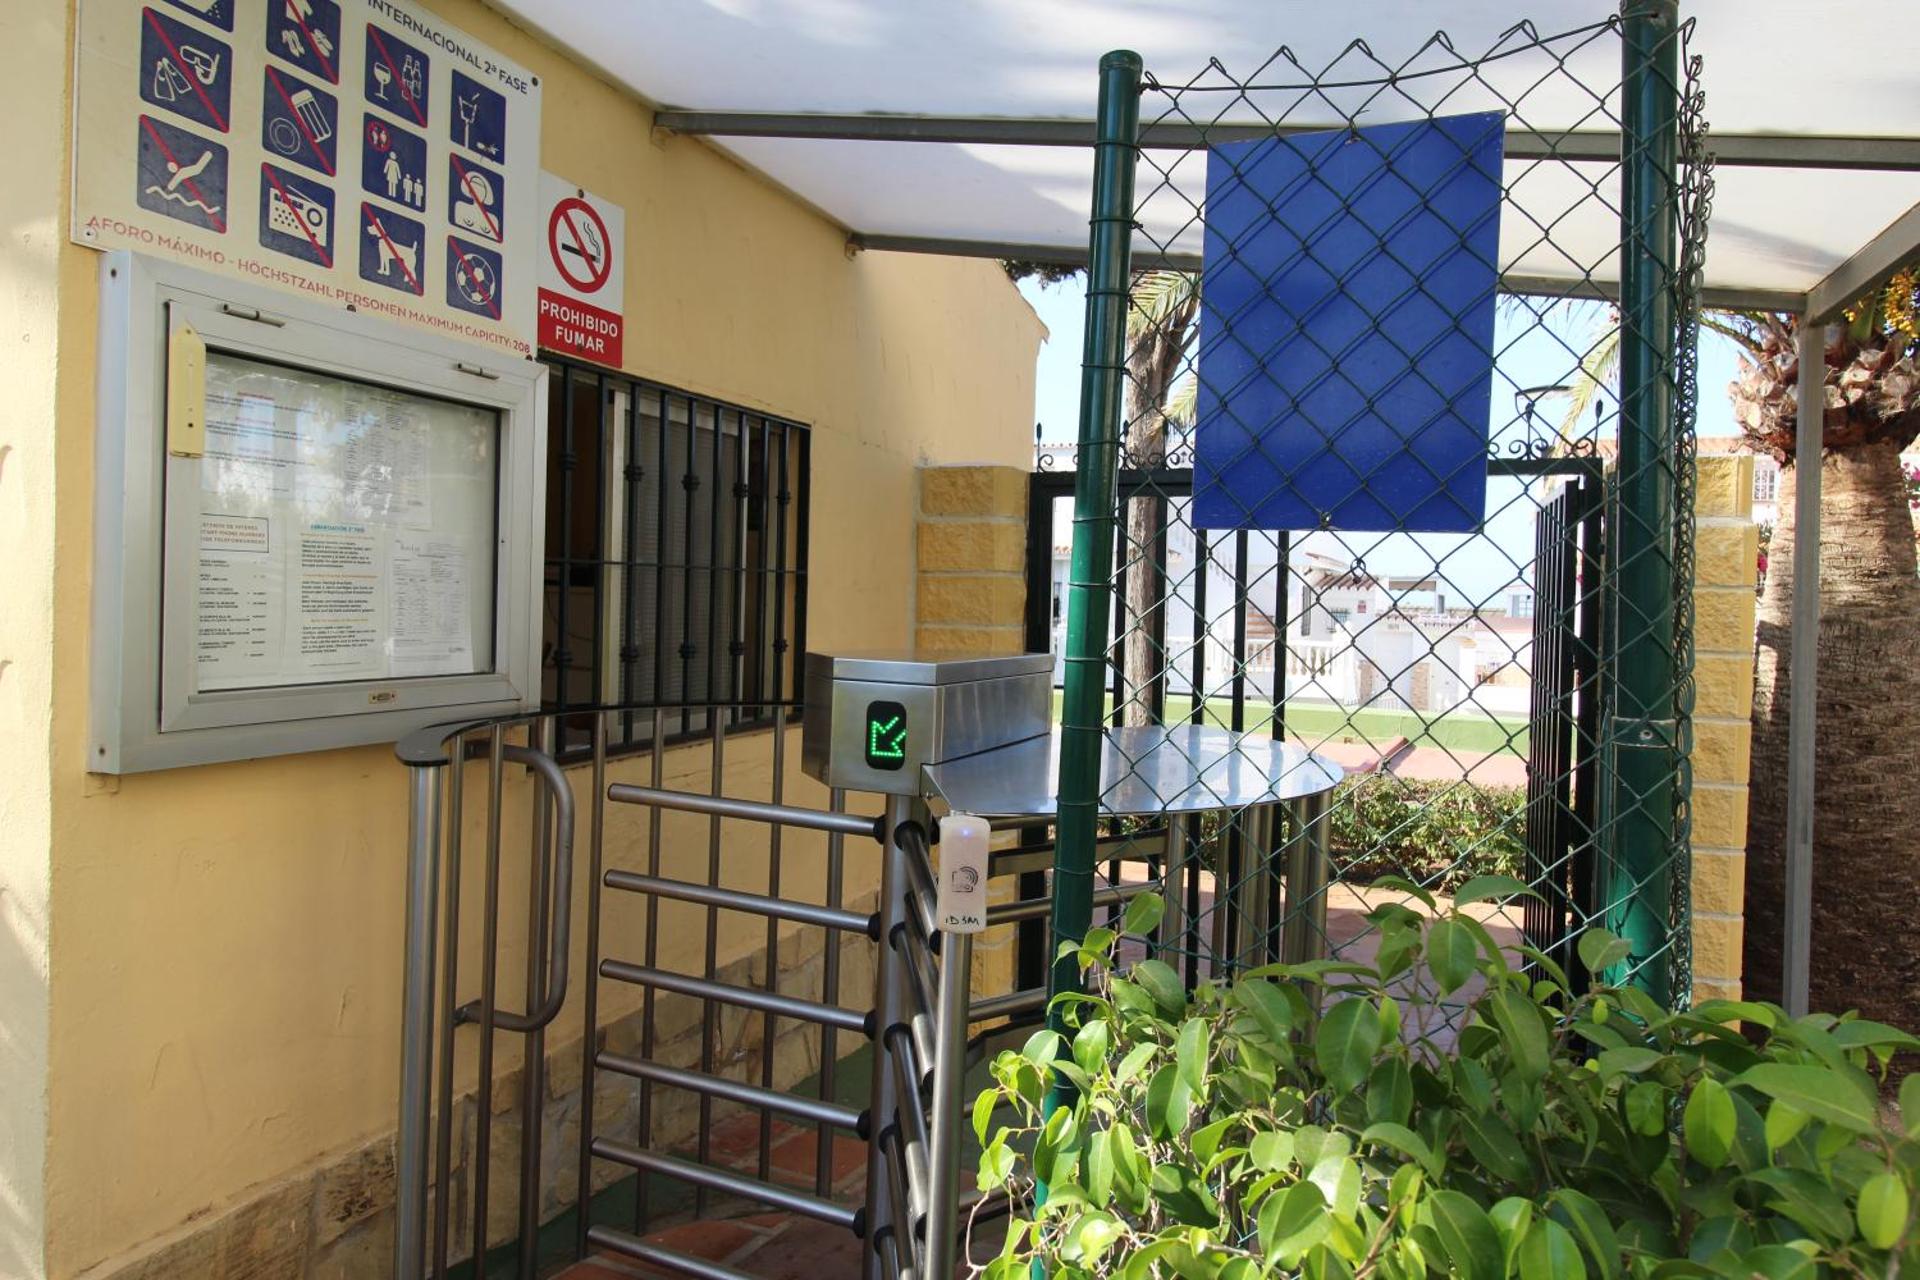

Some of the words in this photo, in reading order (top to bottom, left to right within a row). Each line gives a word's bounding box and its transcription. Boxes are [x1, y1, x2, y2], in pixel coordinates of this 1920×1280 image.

[498, 69, 528, 95] FASE
[86, 215, 154, 243] AFORO
[157, 235, 226, 265] MÁXIMO
[237, 259, 334, 298] HÖCHSTZAHL
[336, 289, 407, 318] PERSONEN
[409, 310, 464, 334] MAXIMUM
[541, 299, 618, 338] PROHIBIDO
[555, 325, 605, 354] FUMAR
